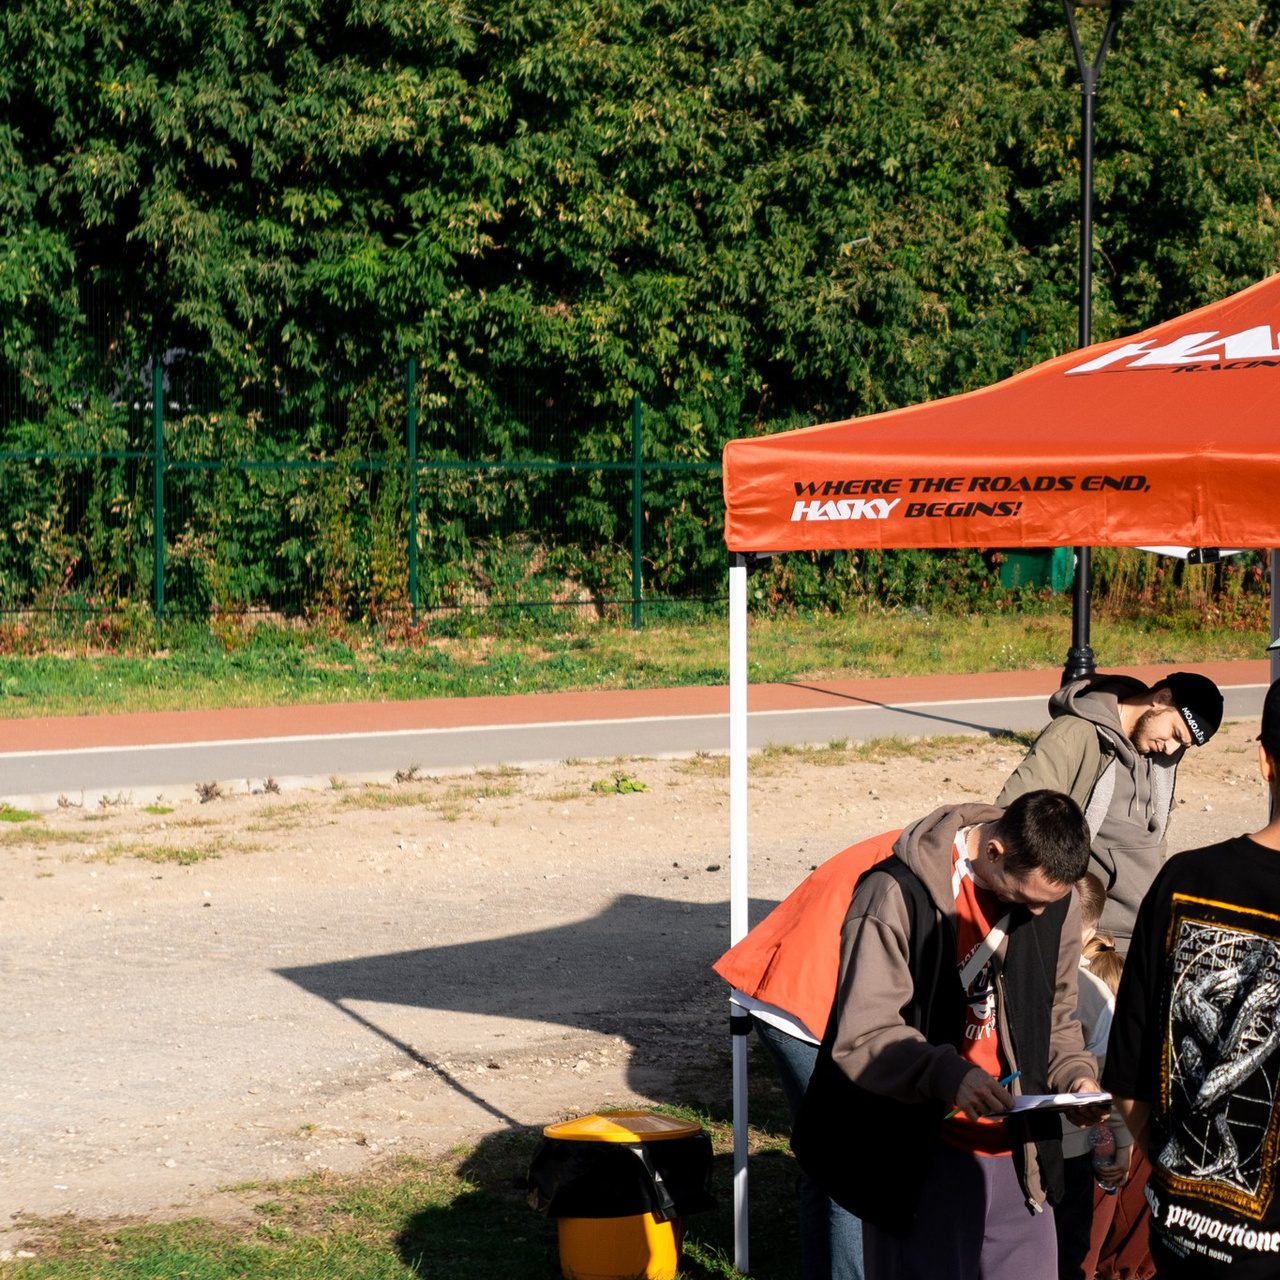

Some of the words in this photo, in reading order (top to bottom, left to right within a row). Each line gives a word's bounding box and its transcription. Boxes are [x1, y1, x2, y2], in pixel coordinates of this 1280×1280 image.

[793, 478, 902, 497] WHERE
[908, 477, 966, 494] THE
[967, 475, 1076, 493] ROADS
[1080, 475, 1152, 494] END,
[790, 498, 902, 522] HASKY
[904, 501, 1023, 519] BEGINS!
